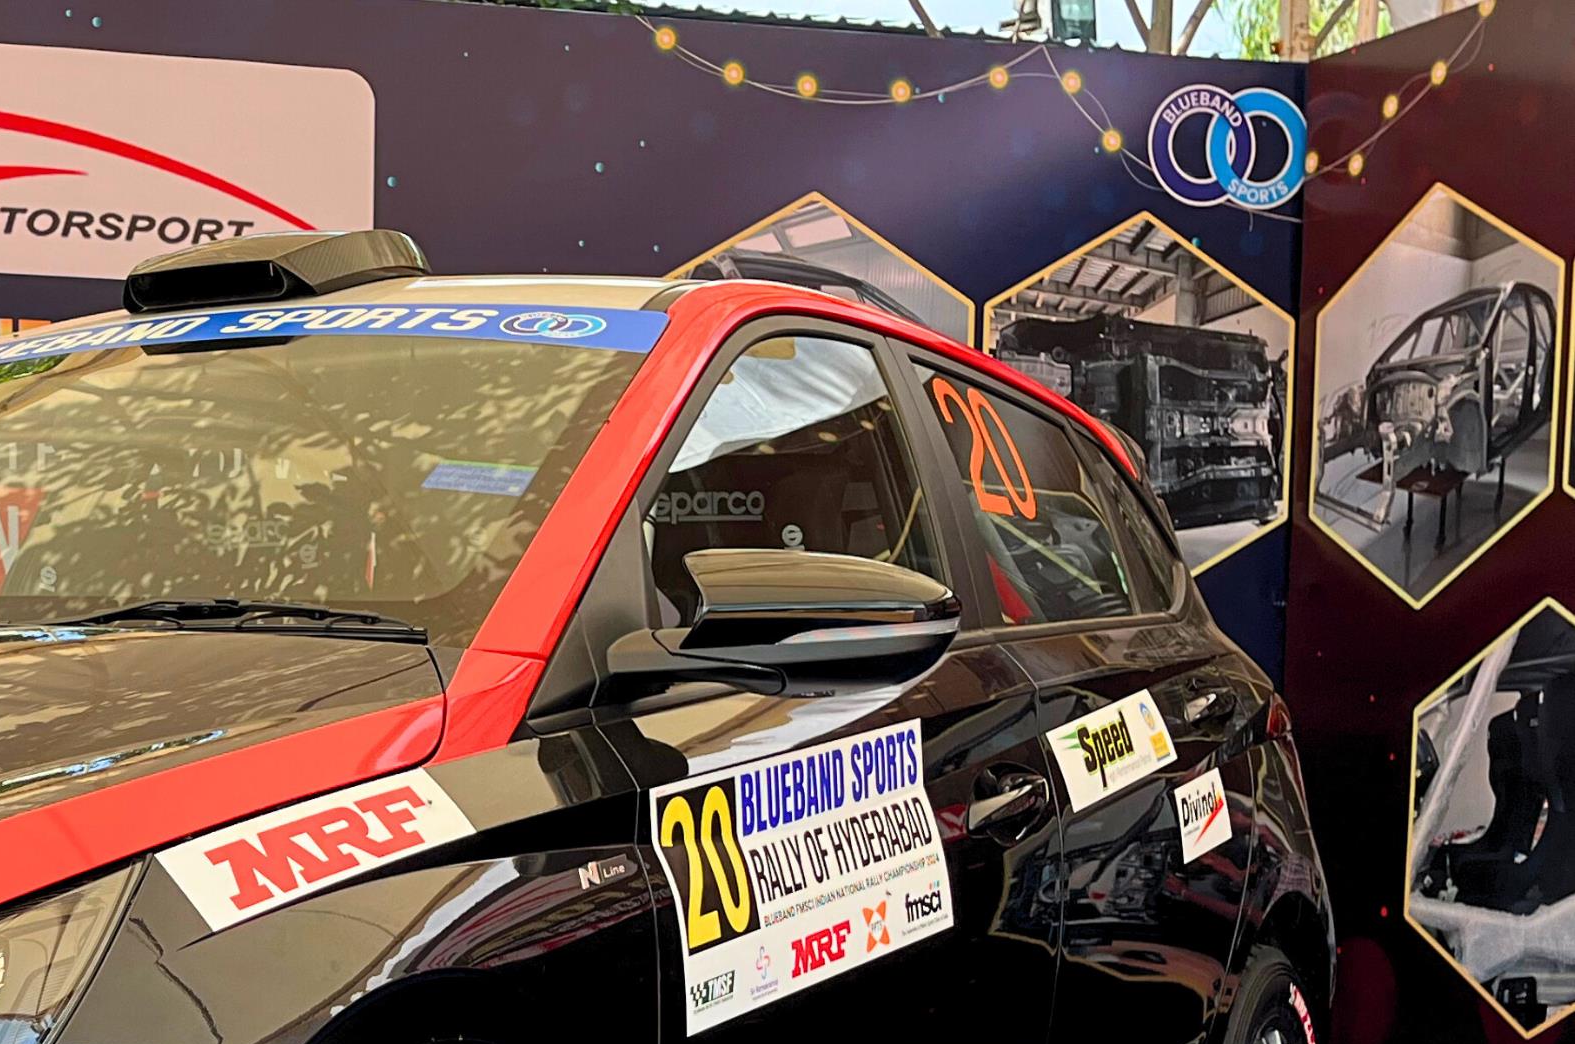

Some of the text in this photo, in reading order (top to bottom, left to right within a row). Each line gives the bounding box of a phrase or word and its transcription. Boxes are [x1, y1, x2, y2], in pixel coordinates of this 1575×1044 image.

[1162, 91, 1242, 127] BLUEBAND
[1228, 179, 1289, 203] SPORTS
[220, 307, 499, 333] SPORTS
[932, 377, 1037, 520] 20
[740, 729, 918, 836] BLUEBAND SPORTS
[1076, 710, 1133, 790] Speed
[1181, 781, 1218, 828] Divinol
[204, 785, 425, 911] MRF
[578, 861, 626, 890] N Line
[660, 786, 751, 949] 20
[748, 796, 933, 904] RALLY OF HYDERABAD
[791, 920, 851, 979] MRF
